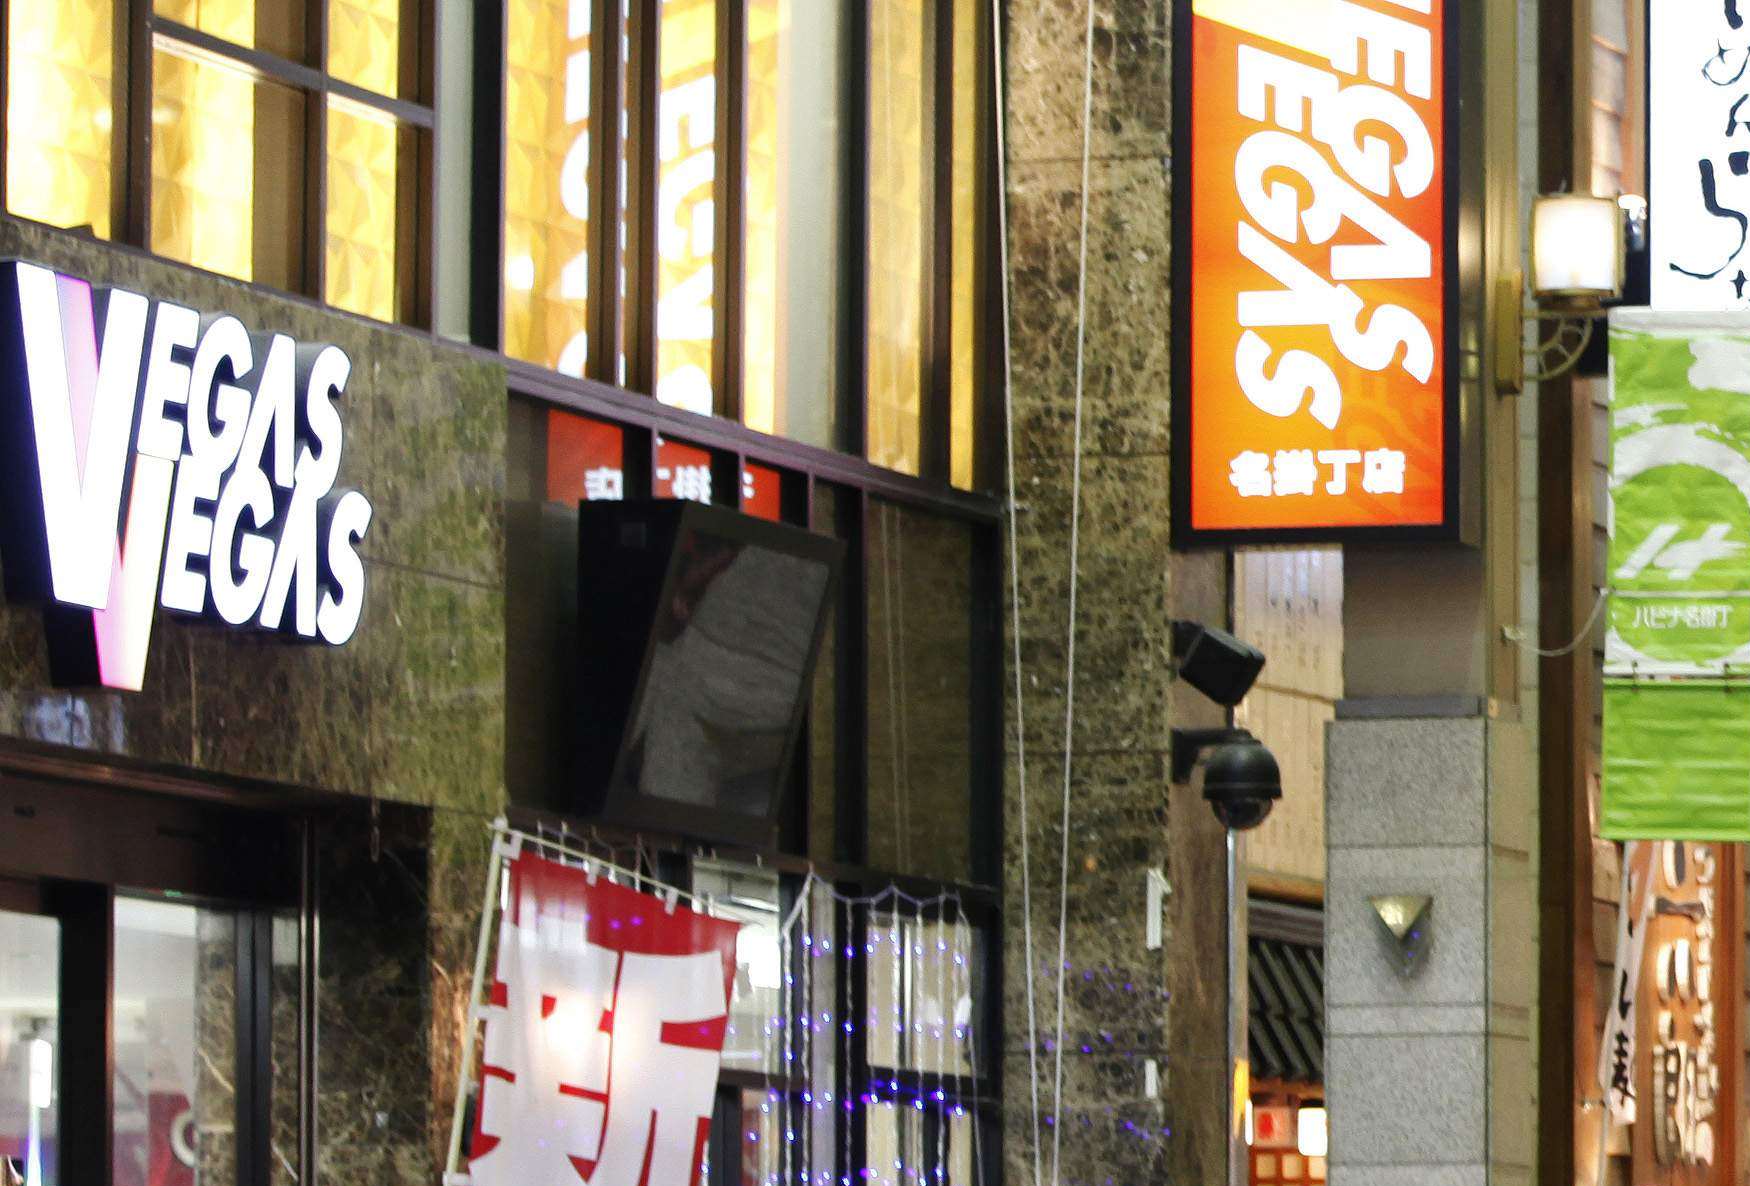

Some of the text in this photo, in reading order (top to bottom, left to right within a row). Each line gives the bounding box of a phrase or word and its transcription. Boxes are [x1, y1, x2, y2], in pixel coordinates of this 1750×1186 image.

[1328, 0, 1434, 384] EGAS
[17, 261, 351, 610] VEGAS
[92, 452, 373, 691] VEGAS
[1229, 447, 1406, 498] 名掛丁店
